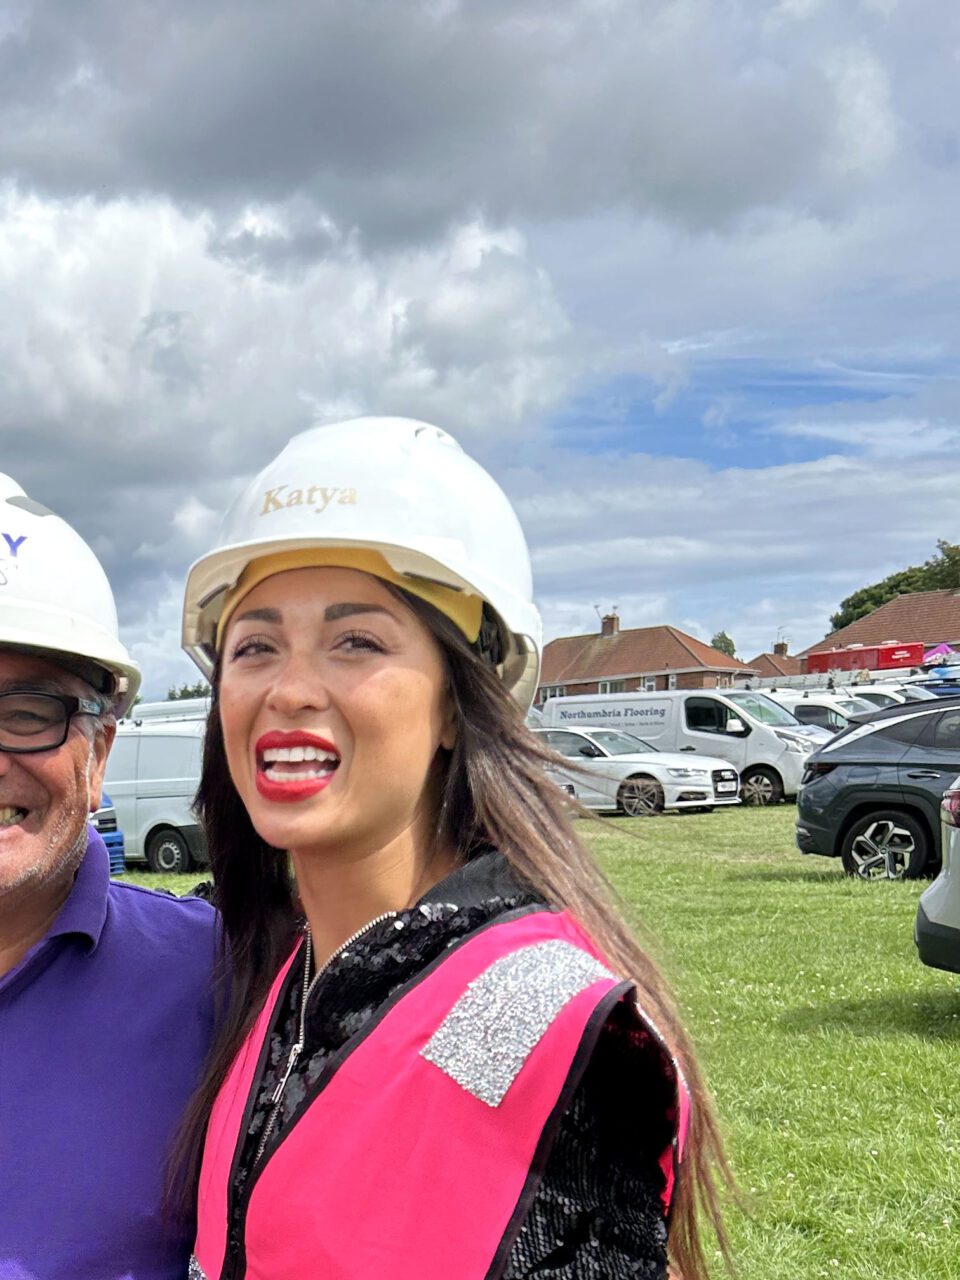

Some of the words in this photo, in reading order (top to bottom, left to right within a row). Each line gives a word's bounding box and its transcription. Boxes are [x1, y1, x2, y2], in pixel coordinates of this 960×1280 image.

[259, 484, 358, 516] Katya
[559, 708, 622, 720] Northumbria
[623, 707, 666, 718] Flooring
